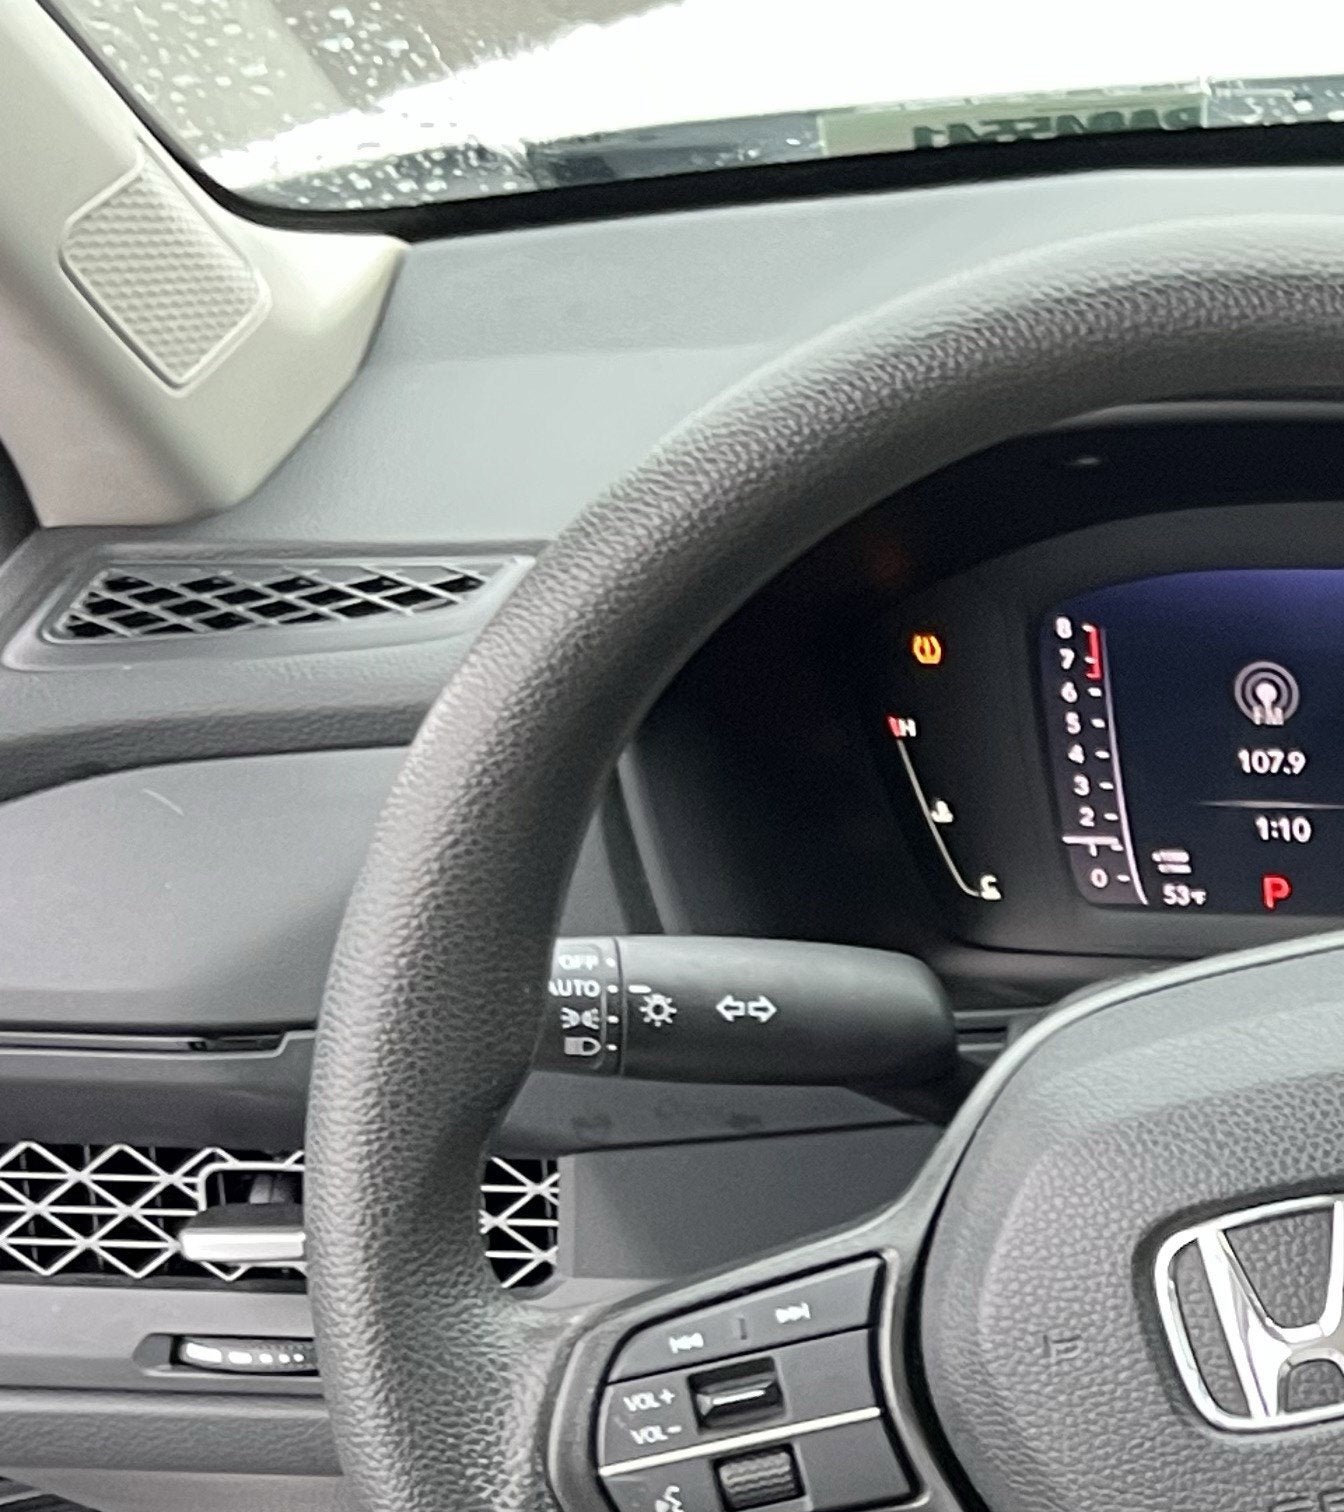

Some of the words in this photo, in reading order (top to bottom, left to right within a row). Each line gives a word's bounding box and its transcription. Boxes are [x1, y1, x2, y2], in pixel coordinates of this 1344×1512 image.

[1056, 616, 1073, 639] 8
[1060, 647, 1075, 670] 7
[1061, 681, 1078, 703] 6
[1065, 711, 1081, 734] 5
[1068, 744, 1085, 764] 4
[1238, 749, 1306, 775] 107.9
[1073, 773, 1090, 796] 3
[1078, 805, 1095, 827] 2
[1255, 815, 1312, 843] 1:10
[1089, 868, 1109, 888] 0
[1262, 875, 1292, 909] P
